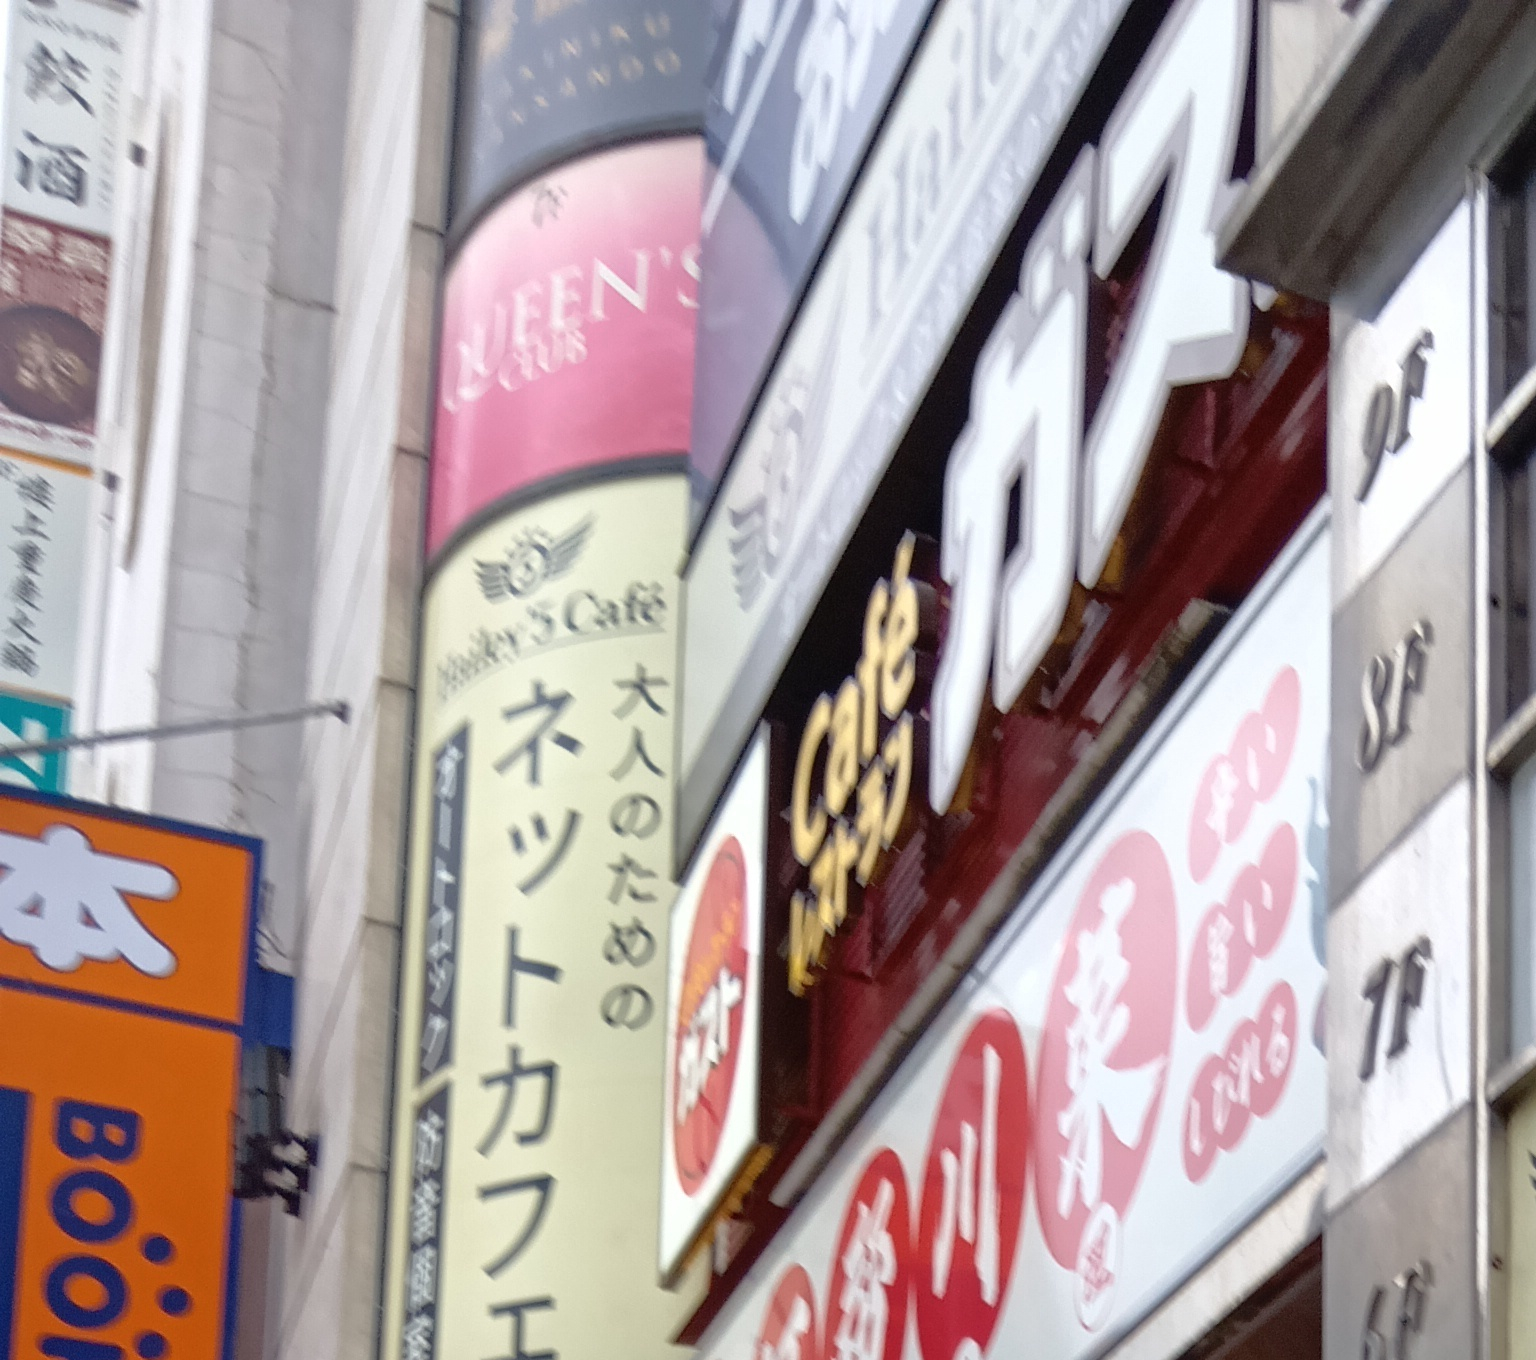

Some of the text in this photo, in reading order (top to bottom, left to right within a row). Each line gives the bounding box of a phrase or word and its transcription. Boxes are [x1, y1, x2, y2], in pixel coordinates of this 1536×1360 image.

[1356, 326, 1435, 504] 9F
[792, 529, 918, 866] Café
[1356, 618, 1435, 774] 8F
[0, 823, 181, 979] 本
[602, 664, 669, 1032] 大人のための
[1357, 935, 1434, 1083] 7F
